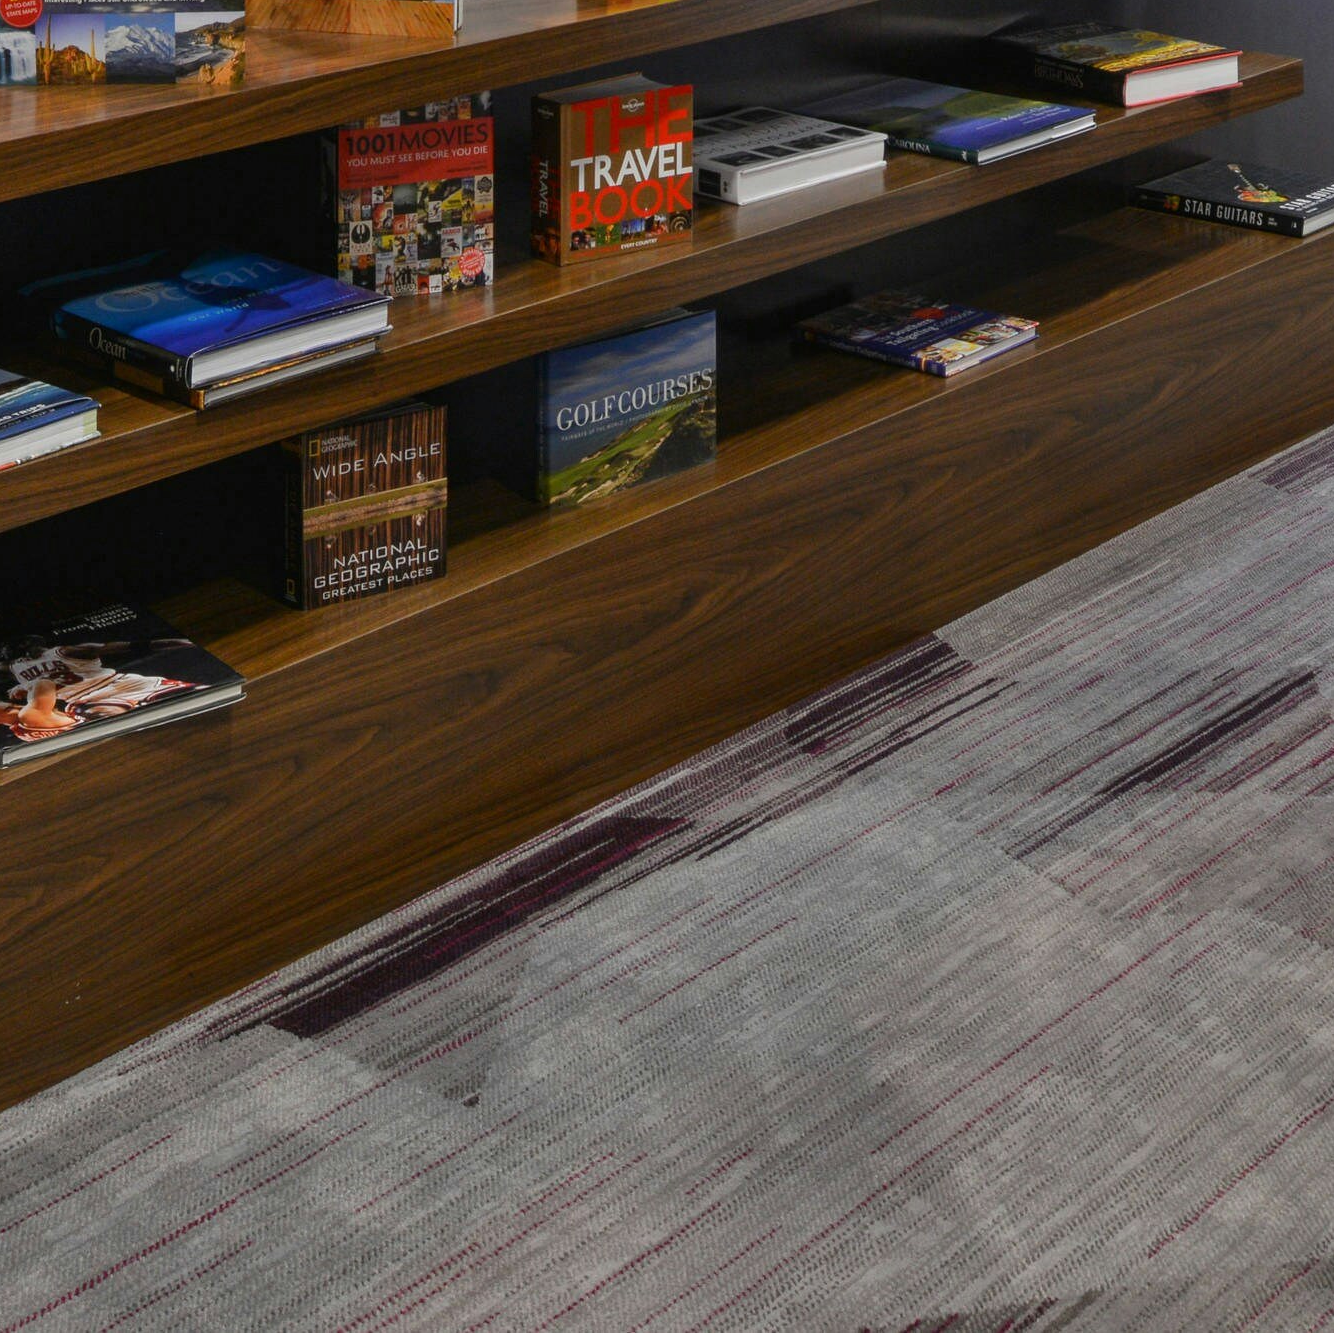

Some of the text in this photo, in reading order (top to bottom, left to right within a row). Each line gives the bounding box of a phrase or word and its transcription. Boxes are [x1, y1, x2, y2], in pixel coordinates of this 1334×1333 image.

[570, 85, 693, 157] THE
[346, 123, 488, 155] 1001 MOVIES
[347, 146, 488, 167] YOU MUST SEE BEFORE YOU DIE
[570, 141, 693, 192] TRAVEL
[538, 160, 550, 218] TRAVEL
[570, 173, 693, 230] BOOK
[1184, 199, 1211, 217] STAR
[1216, 204, 1264, 226] GUITARS
[621, 238, 657, 249] EVERY COUNTRY
[95, 260, 283, 312] Ocean
[90, 326, 126, 360] Ocean
[12, 404, 47, 422] TRIPS
[556, 395, 616, 431] GOLF
[618, 368, 714, 414] COURSES
[322, 435, 349, 445] NATIONAL
[322, 440, 357, 453] GEOGRAPHIC
[313, 442, 441, 480] WIDE ANGLE
[314, 548, 439, 589] GEOGRAPHIC
[334, 538, 427, 569] NATIONAL
[323, 566, 434, 600] GREATEST PLACES
